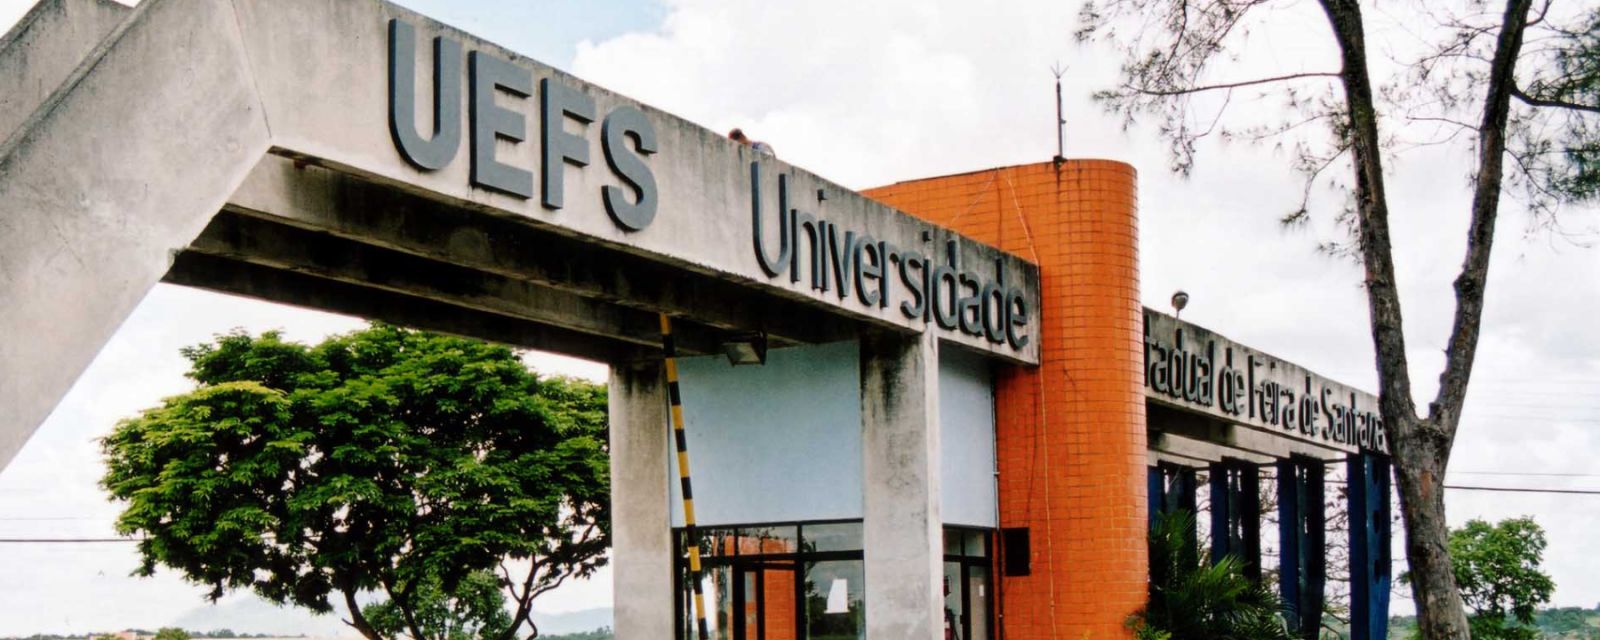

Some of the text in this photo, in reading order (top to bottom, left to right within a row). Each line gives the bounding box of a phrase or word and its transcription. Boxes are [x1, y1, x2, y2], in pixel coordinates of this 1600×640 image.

[388, 18, 658, 232] UEFS
[751, 161, 1028, 350] Universidade
[1218, 347, 1245, 416] de
[1247, 354, 1296, 430] Feira
[1299, 376, 1319, 437] de
[1320, 384, 1390, 455] Santana
